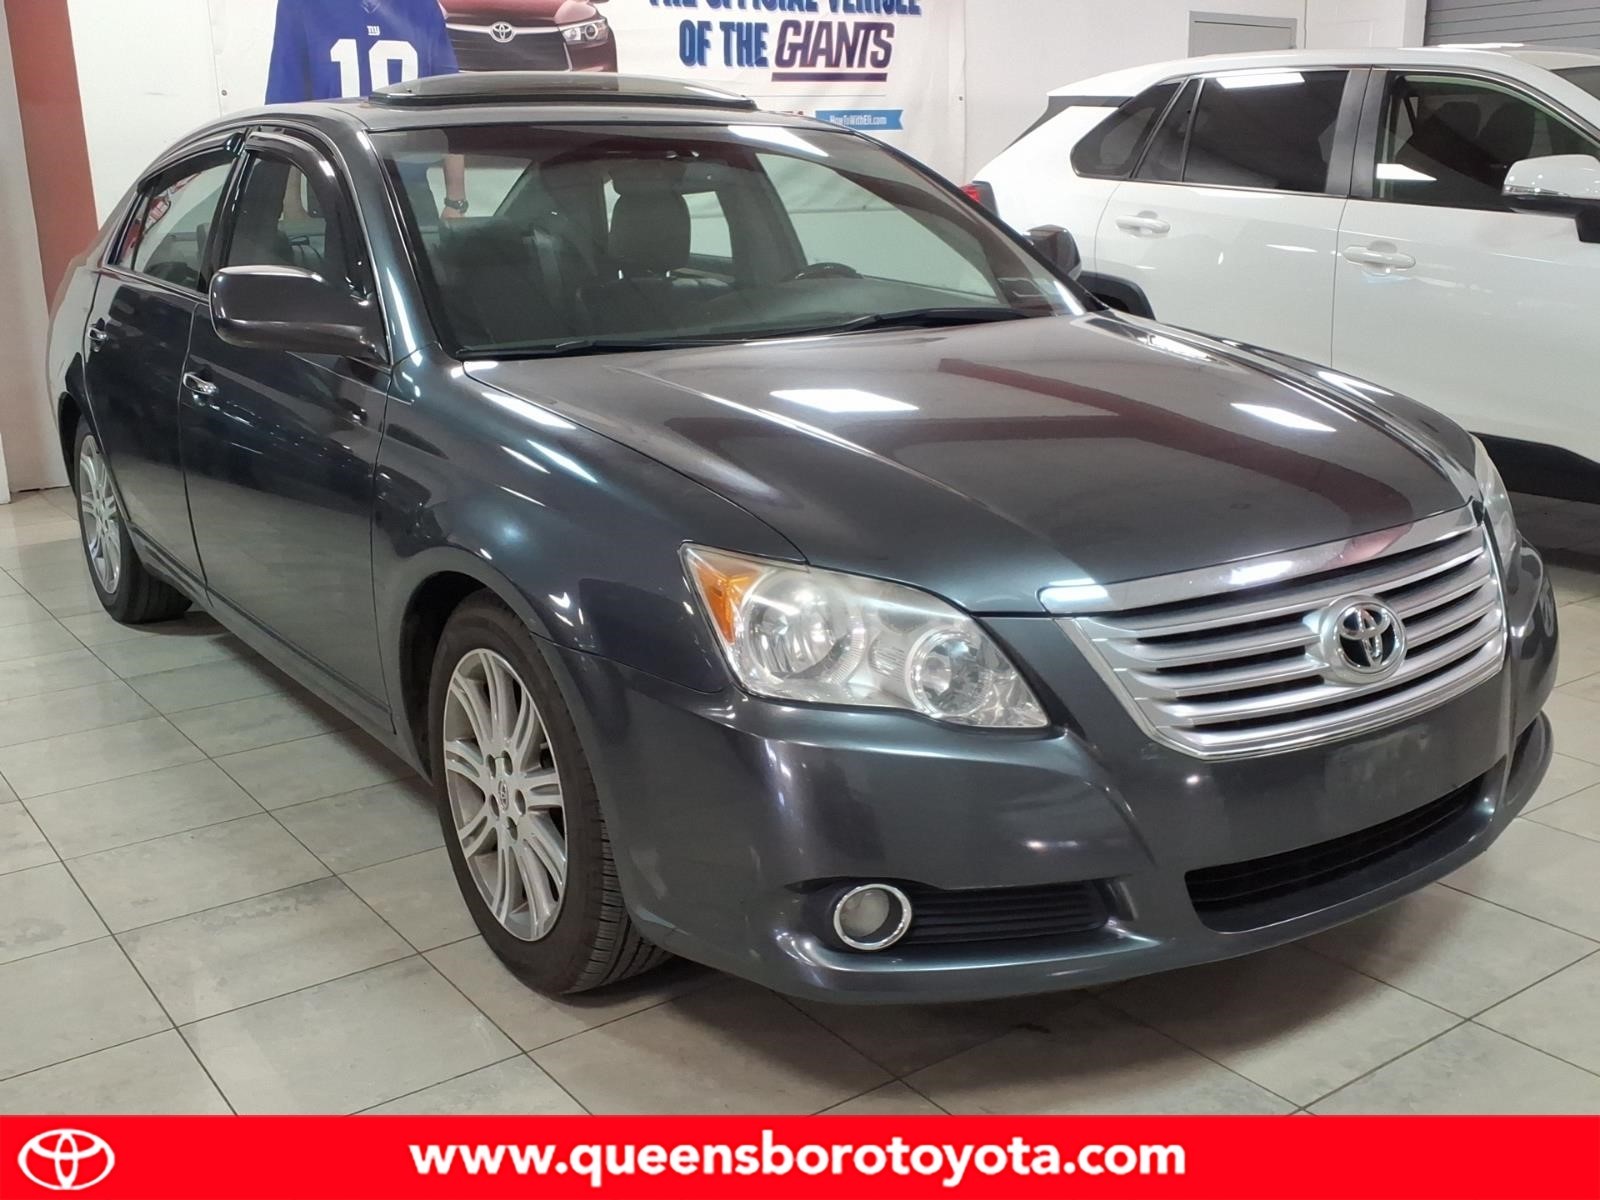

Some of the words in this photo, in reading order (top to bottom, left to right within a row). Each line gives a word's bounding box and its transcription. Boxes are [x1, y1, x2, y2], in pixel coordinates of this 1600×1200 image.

[330, 38, 419, 98] 10
[678, 19, 713, 67] OF
[719, 21, 769, 68] THE
[774, 19, 895, 69] GIANTS
